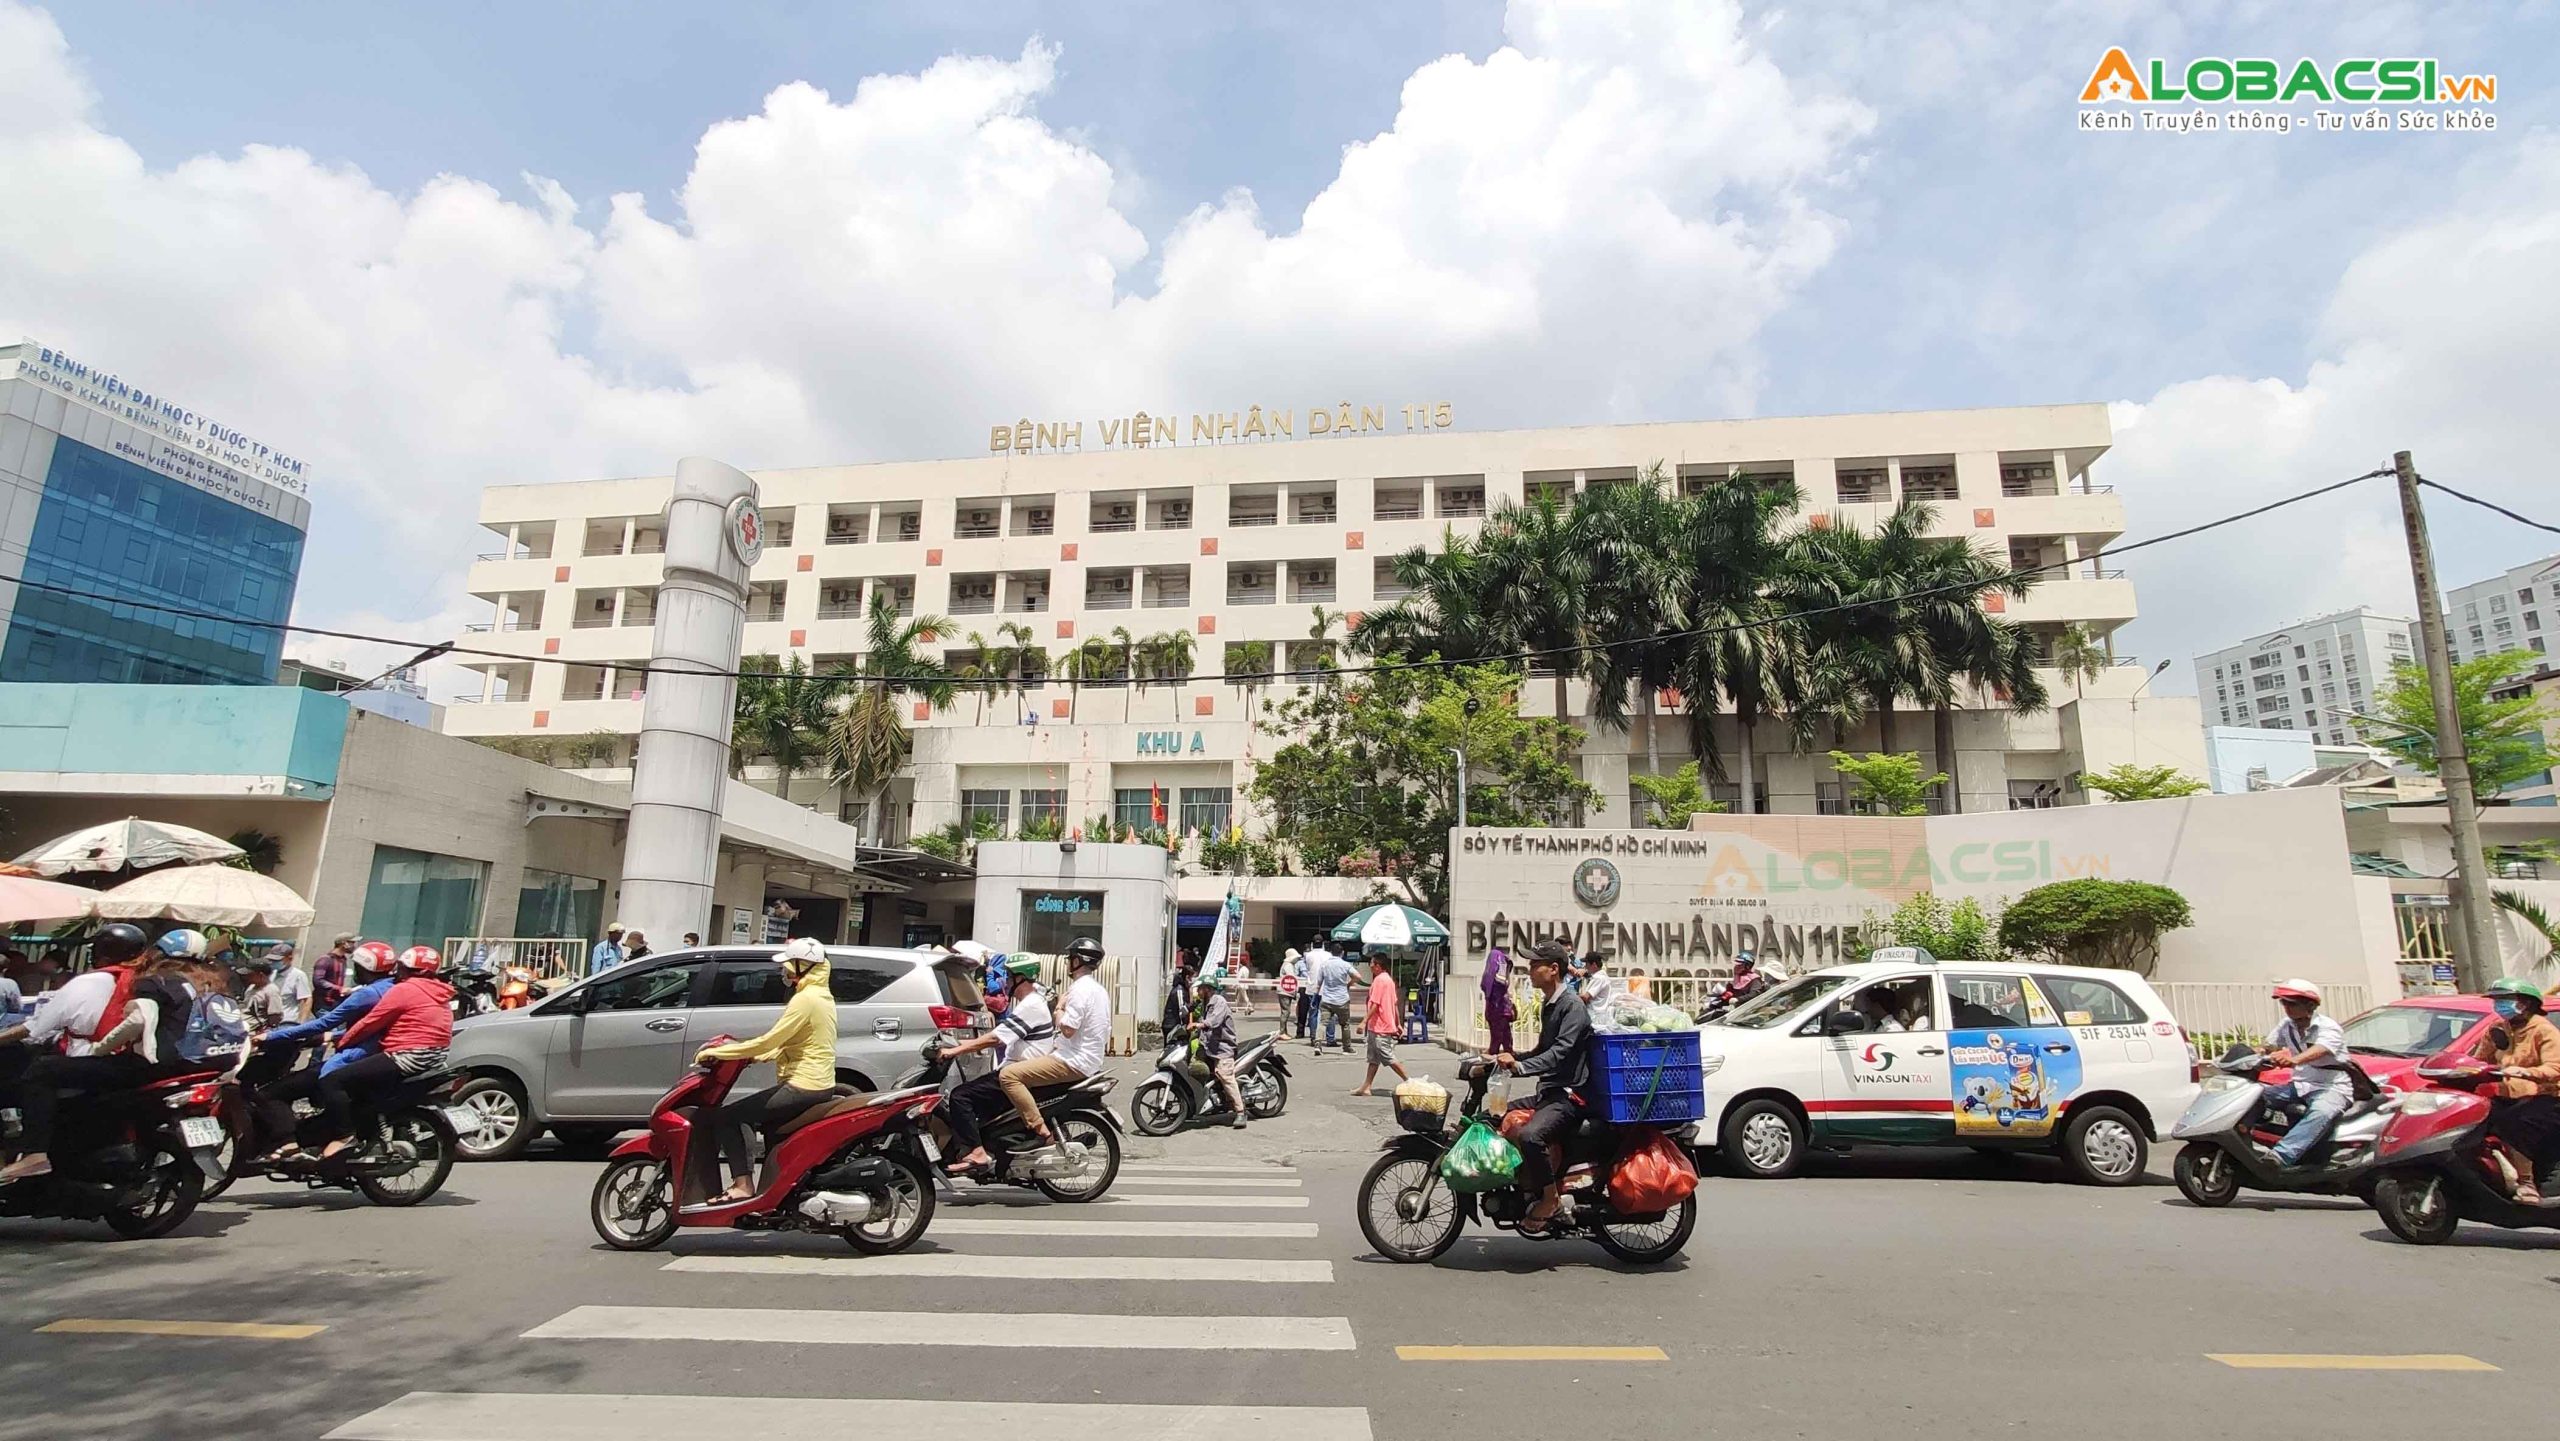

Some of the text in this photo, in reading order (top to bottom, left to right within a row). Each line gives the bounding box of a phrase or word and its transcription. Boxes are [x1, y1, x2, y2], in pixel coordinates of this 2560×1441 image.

[41, 347, 87, 379] BỆNH
[91, 370, 129, 398] VIỆN
[133, 389, 159, 411] ĐẠI
[197, 417, 206, 431] Y
[208, 424, 248, 450] DƯỢC
[252, 442, 302, 475] TP.HCM
[79, 387, 121, 414] KHÁM
[990, 400, 1452, 455] BỆNH VIỆN NHÂN DÂN 115
[164, 447, 239, 484] PHÒNG KHÁM
[1137, 731, 1205, 753] KHU A
[1464, 832, 1707, 854] SỞ Y TẾ THÀNH PHỐ HỒ CHÍ MINH
[1035, 893, 1089, 913] CỔNG SỐ 3
[1643, 914, 1733, 957] NHÂN
[1737, 914, 1804, 957] DÂN
[1808, 925, 1861, 957] 115
[2080, 1027, 2100, 1040] 51F
